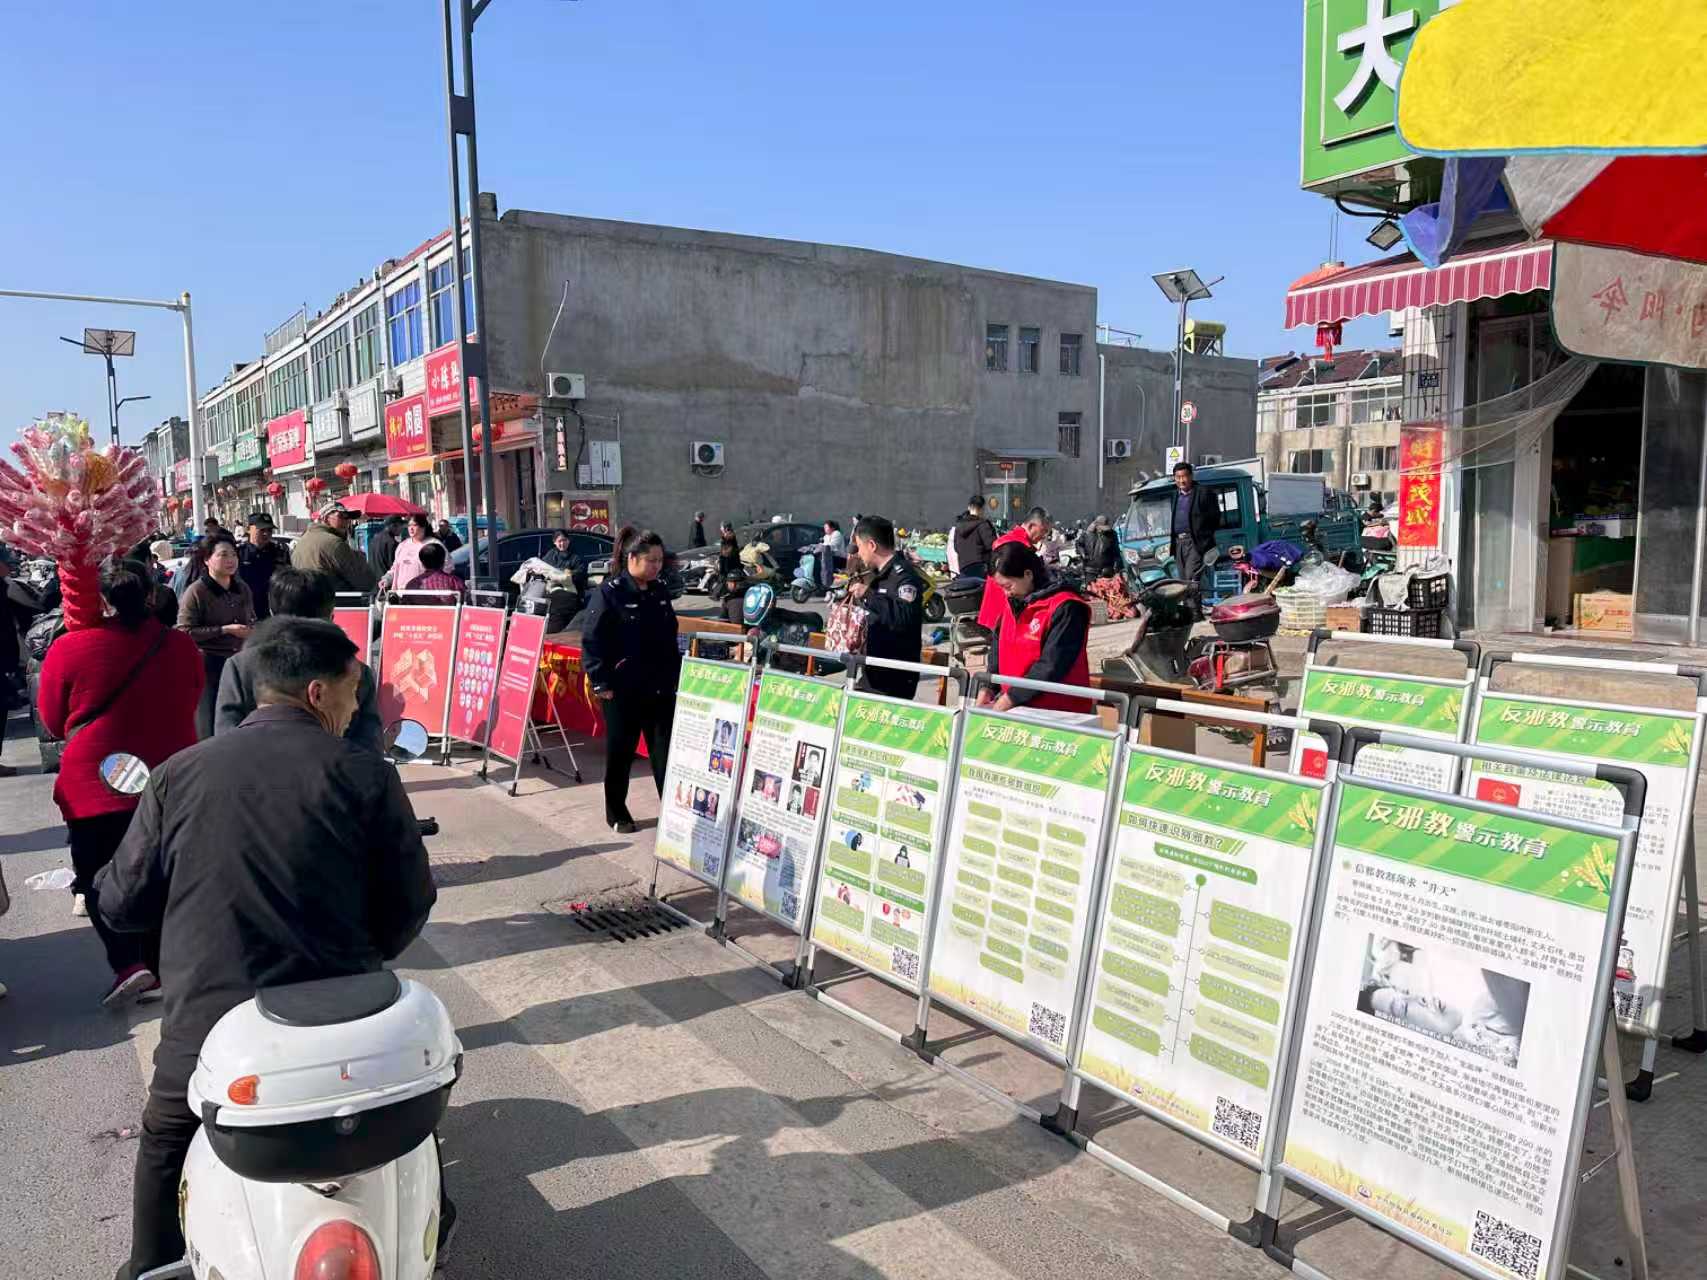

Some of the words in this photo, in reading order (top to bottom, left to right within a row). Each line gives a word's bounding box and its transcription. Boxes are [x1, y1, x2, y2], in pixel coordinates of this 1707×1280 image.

[1321, 678, 1426, 708] 反邪教警示教育
[1500, 704, 1643, 738] 反邪教警示教育
[981, 722, 1080, 757] 反邪教警示教育
[1145, 762, 1272, 808] 反邪教警示教育
[1364, 799, 1550, 861] 反邪教警示教育
